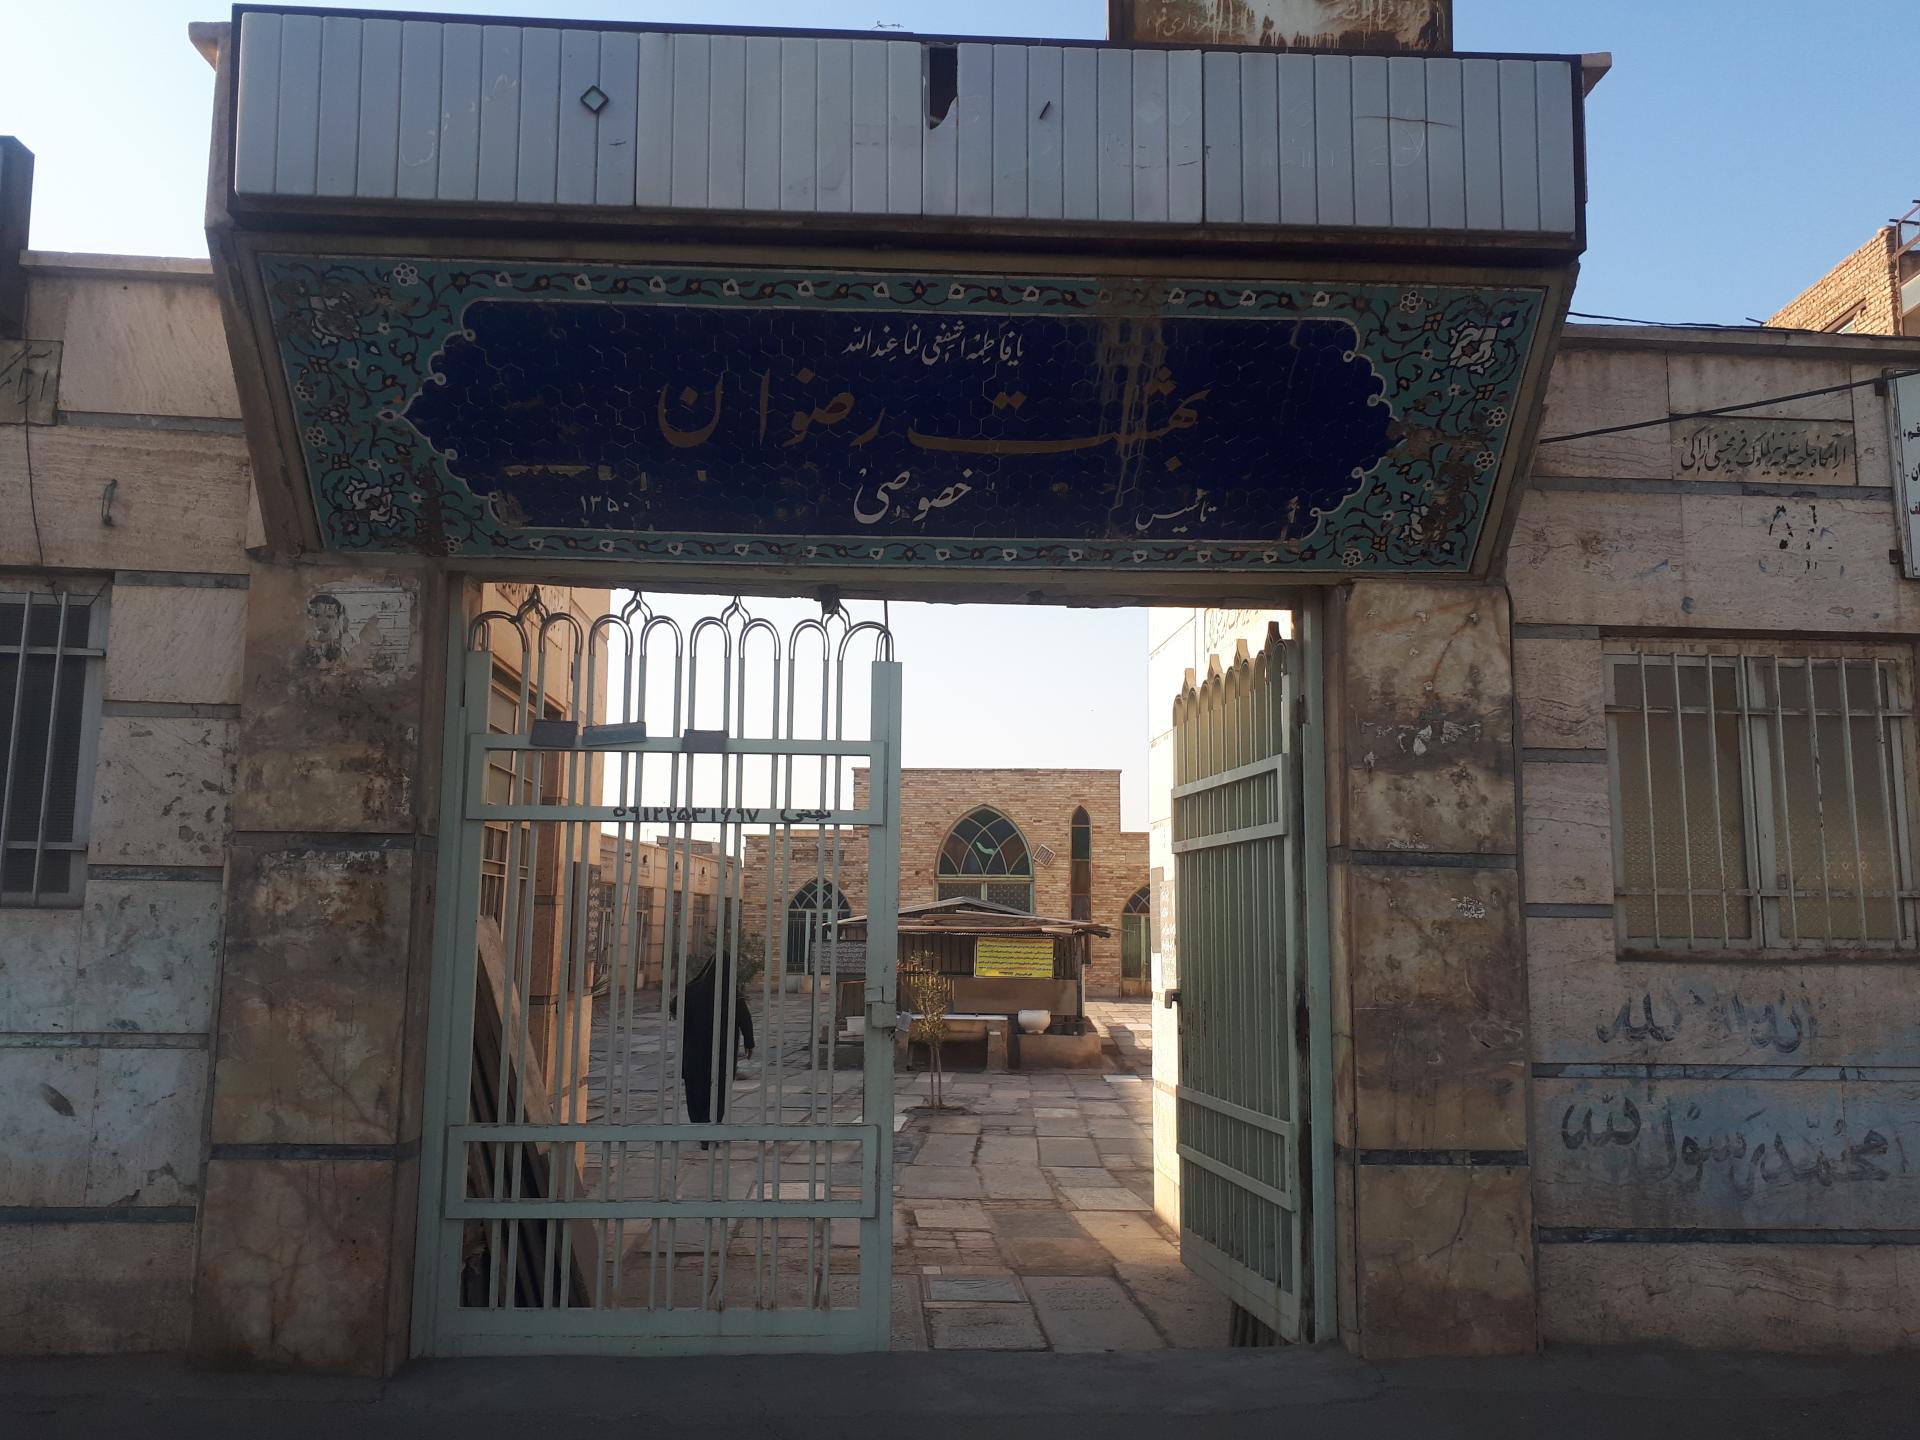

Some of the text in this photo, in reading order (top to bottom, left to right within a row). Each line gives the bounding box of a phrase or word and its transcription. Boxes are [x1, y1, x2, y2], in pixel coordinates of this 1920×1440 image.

[657, 366, 1211, 473] بهشت رضوان
[853, 466, 974, 526] خصوصی
